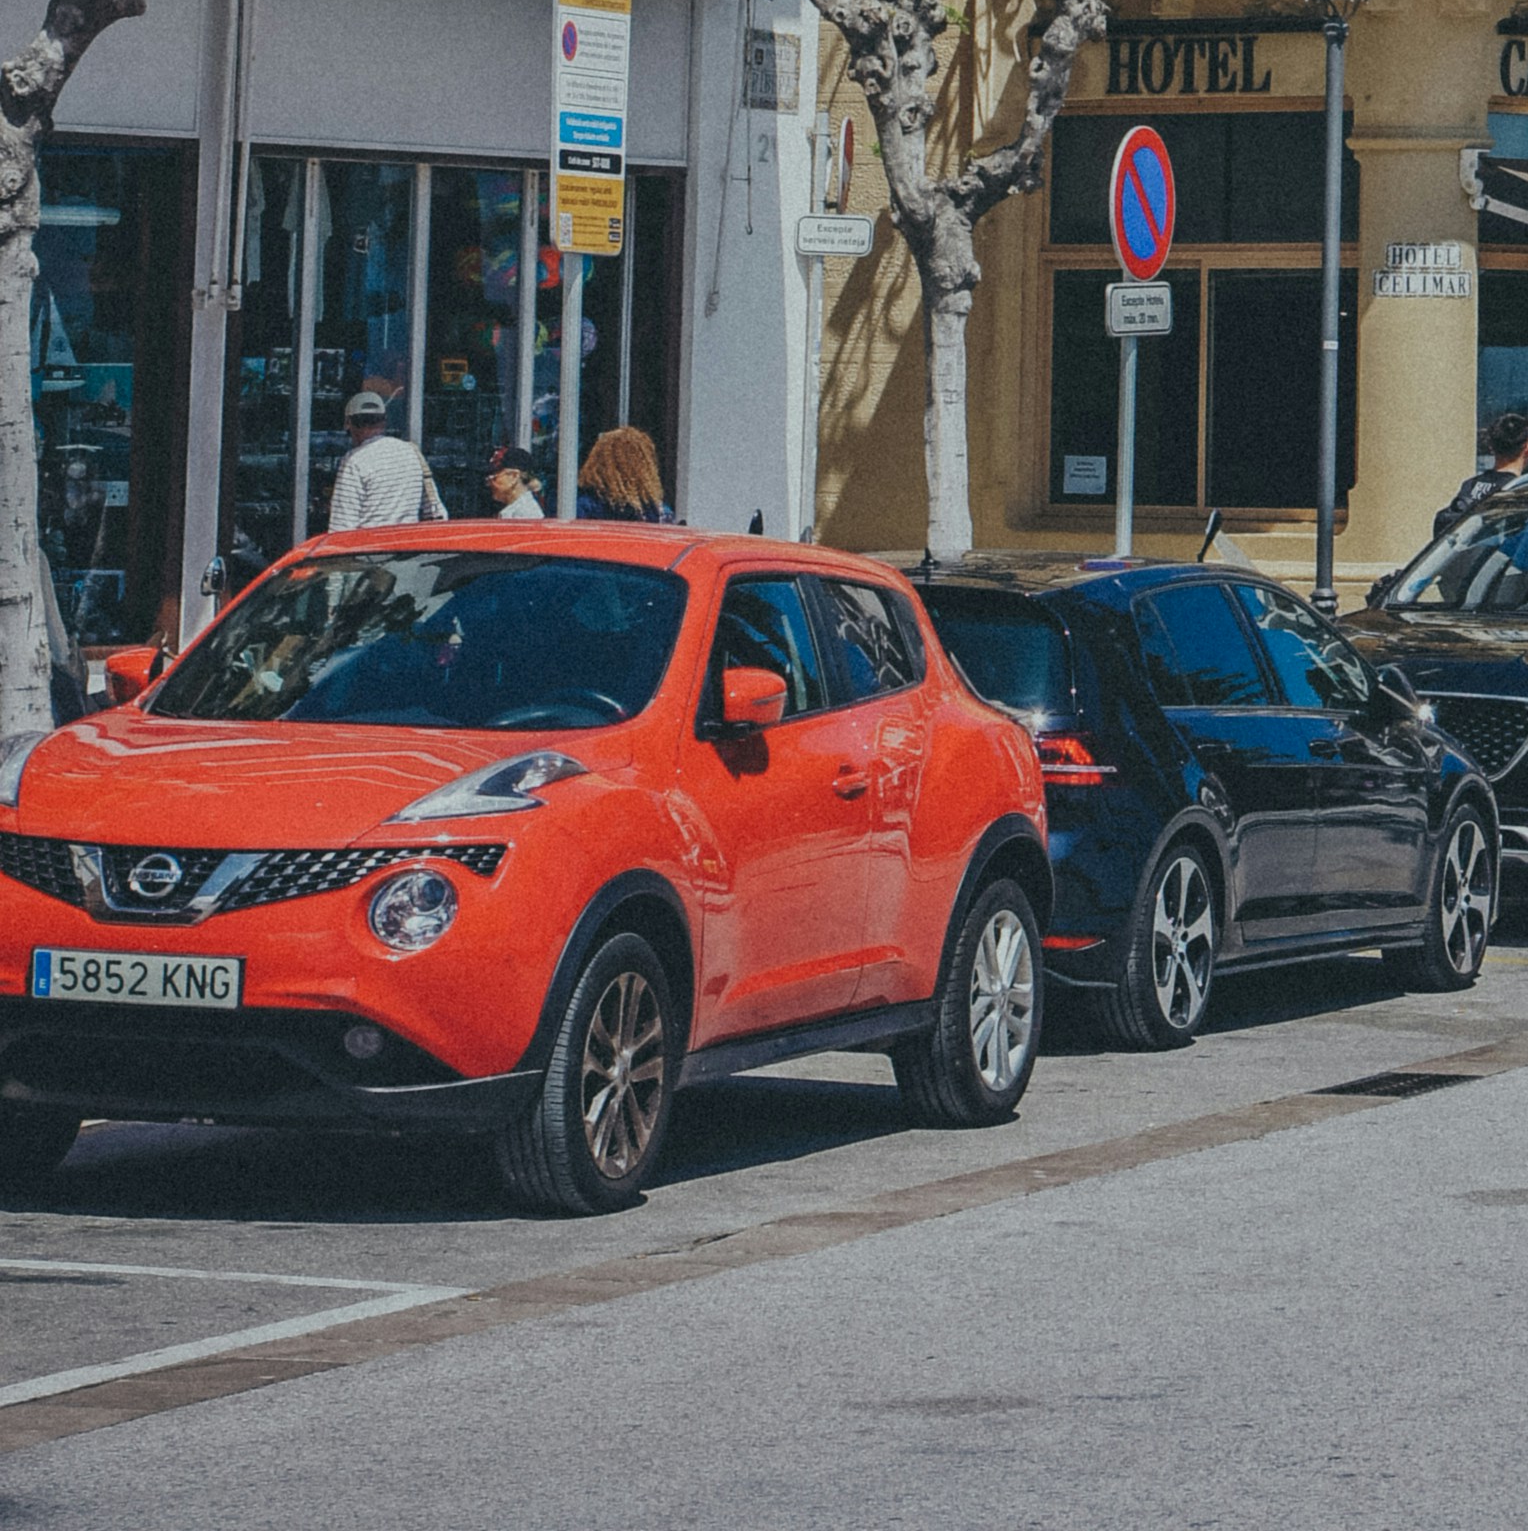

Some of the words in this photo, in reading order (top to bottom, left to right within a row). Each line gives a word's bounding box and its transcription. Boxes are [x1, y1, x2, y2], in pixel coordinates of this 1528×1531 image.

[1105, 35, 1272, 95] HOTEL
[1391, 247, 1457, 266] HOTEL
[1378, 275, 1467, 294] CELIMAR
[133, 869, 176, 881] NISSAN
[60, 957, 149, 996] 5852
[162, 962, 230, 1000] KNG
